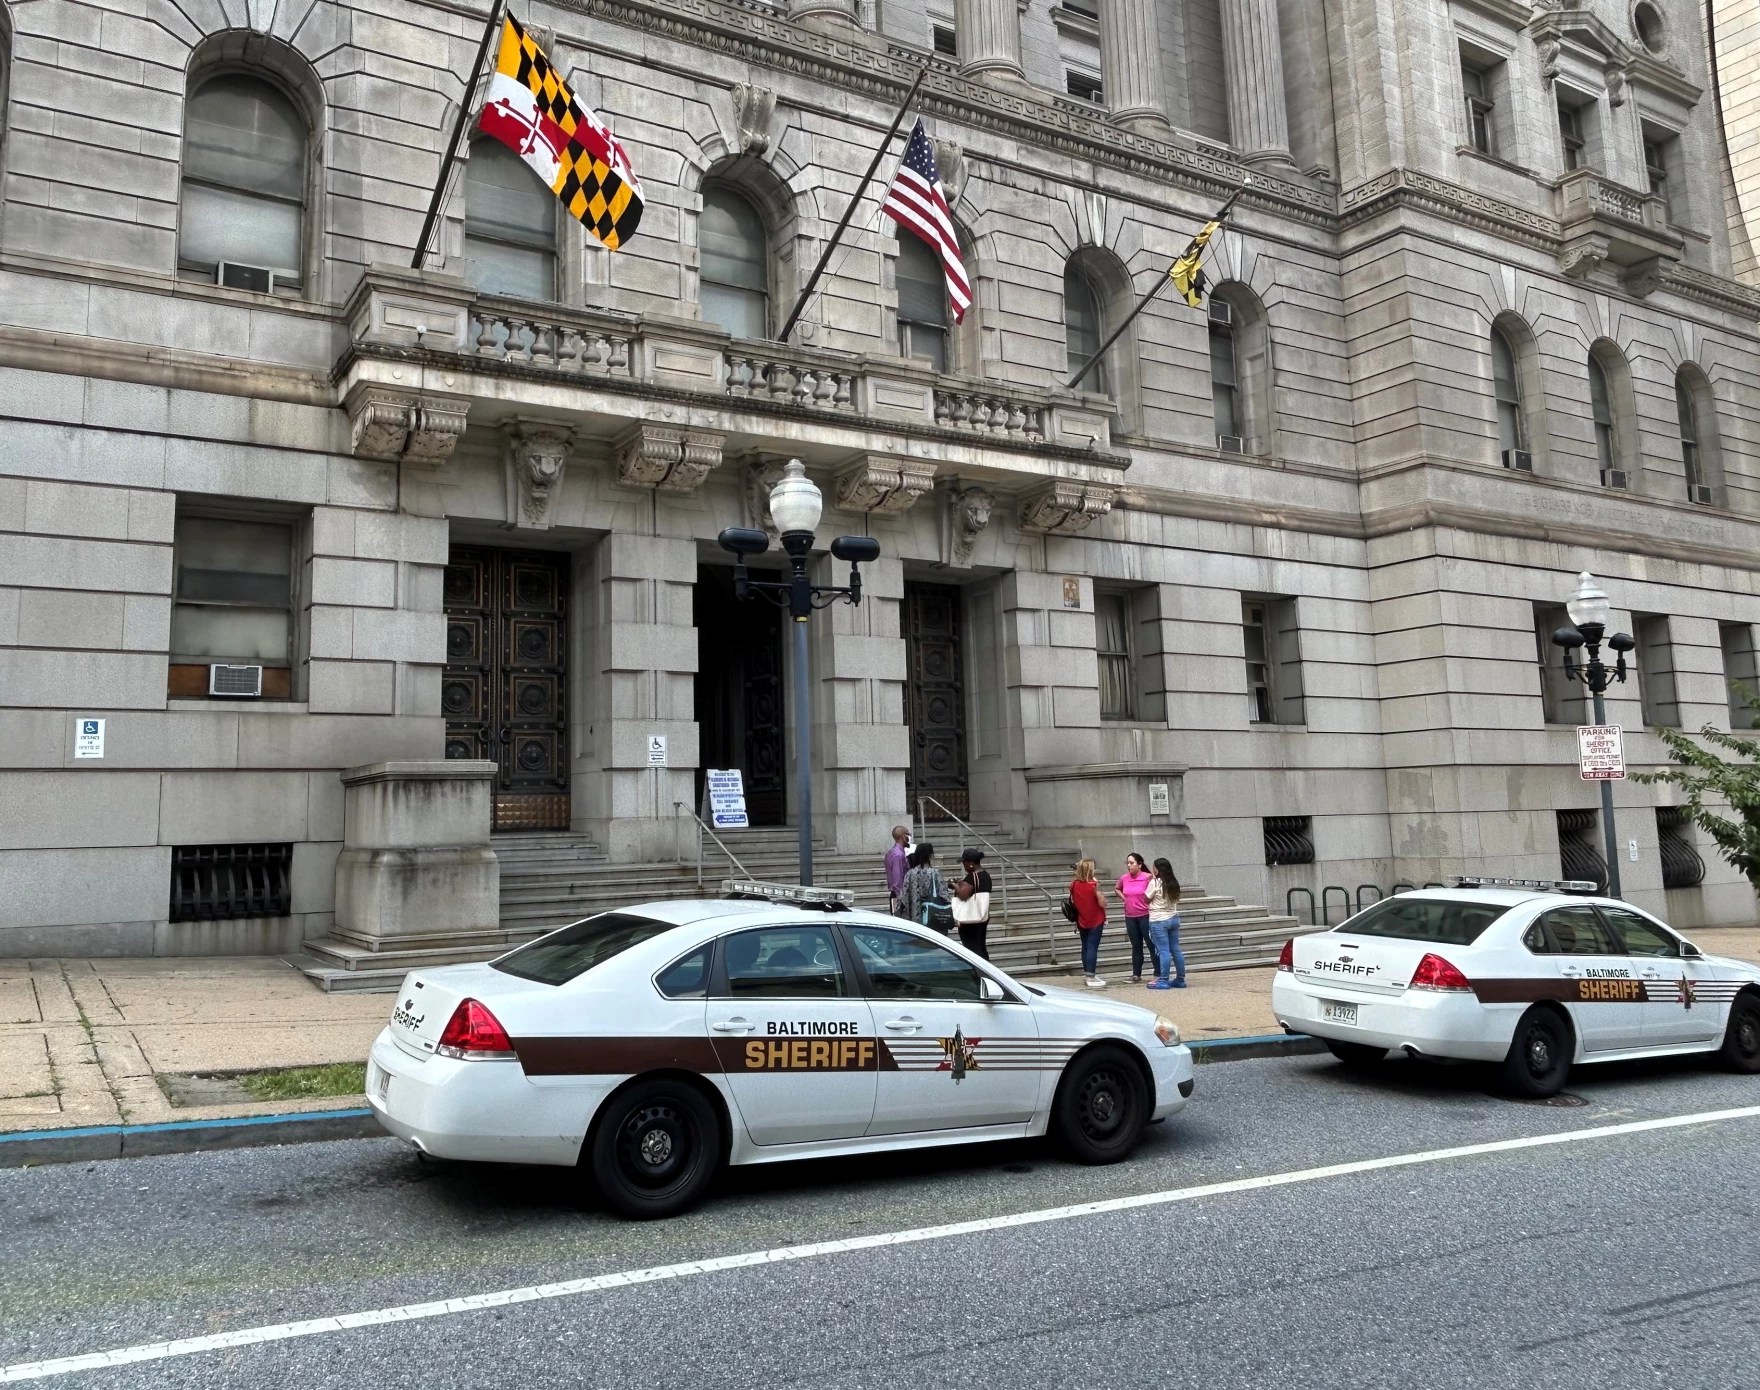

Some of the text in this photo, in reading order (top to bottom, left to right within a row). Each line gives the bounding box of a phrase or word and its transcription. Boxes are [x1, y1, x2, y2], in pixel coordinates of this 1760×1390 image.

[1581, 728, 1617, 736] PARKING
[1314, 960, 1375, 977] SHERIFF
[1586, 968, 1630, 978] BALTIMORE
[1579, 980, 1640, 999] SHERIFF
[393, 1005, 420, 1032] SHERIFF
[767, 1021, 858, 1035] BALTIMORE
[745, 1040, 875, 1068] SHERIFF
